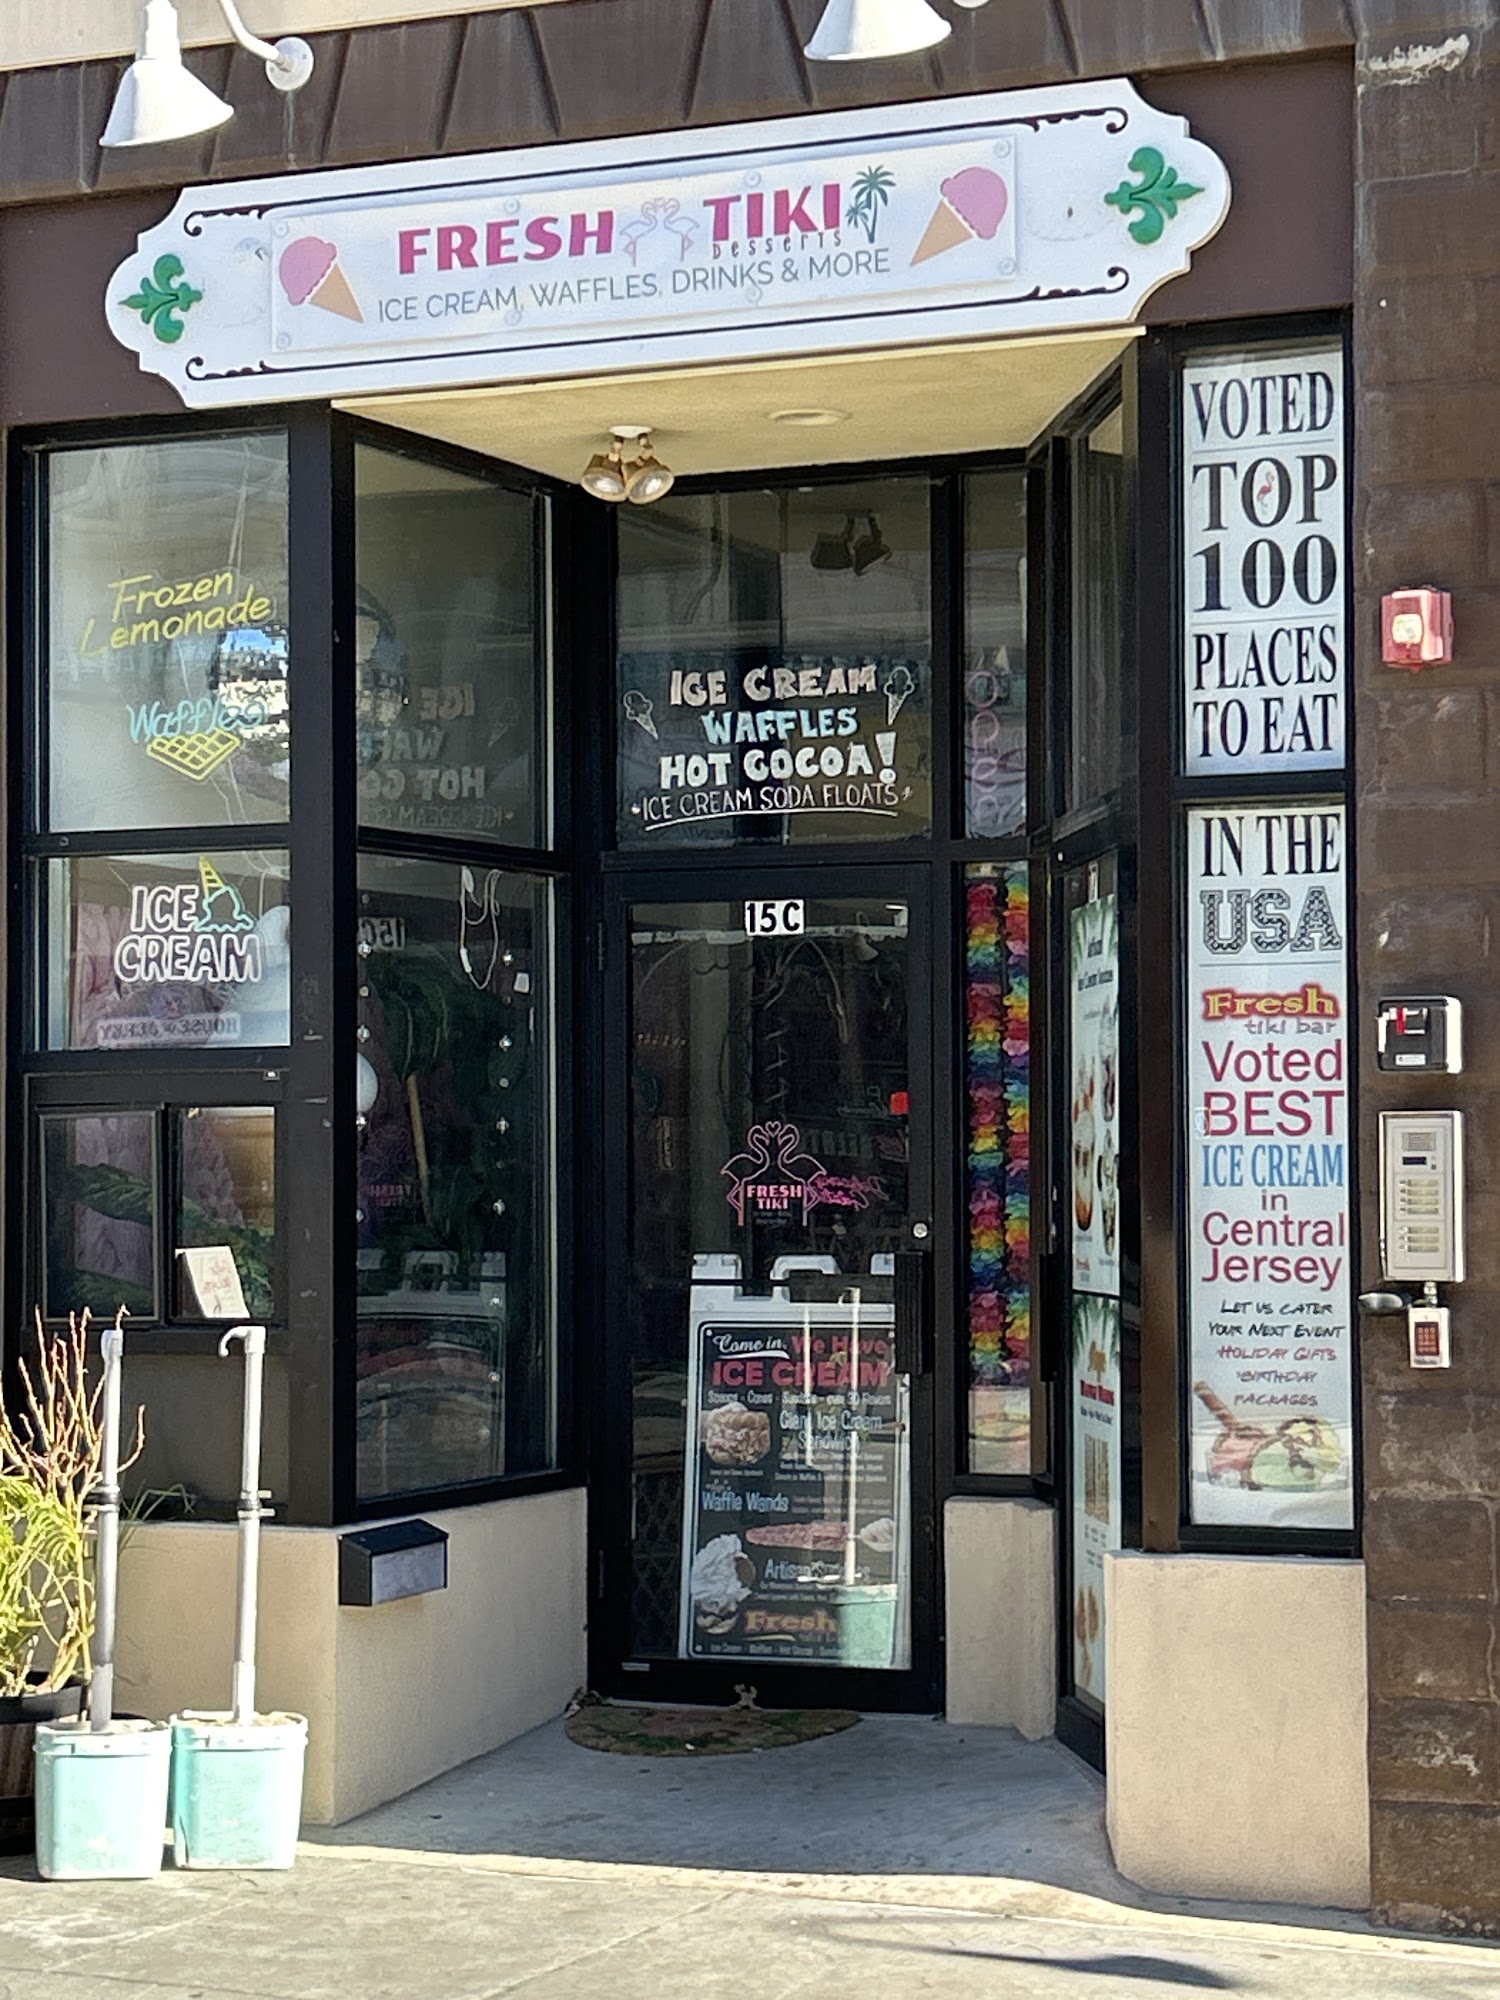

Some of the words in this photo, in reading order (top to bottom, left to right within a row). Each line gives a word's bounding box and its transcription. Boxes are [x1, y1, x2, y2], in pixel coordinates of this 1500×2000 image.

[399, 210, 614, 275] FRESH
[703, 184, 841, 242] TIKI
[378, 297, 418, 322] ICE
[426, 288, 524, 320] CREAM,
[529, 273, 662, 306] WAFFLES,
[671, 260, 773, 295] DRINKS
[781, 258, 799, 282] &
[809, 247, 890, 281] MORE
[1190, 370, 1335, 443] VOTED
[1192, 453, 1338, 532] TOP
[1192, 534, 1338, 612] 100
[107, 569, 234, 622] Frozen
[78, 583, 272, 656] Lemonade
[1193, 624, 1338, 692] PLACES
[670, 670, 727, 706] ICE
[743, 664, 877, 702] CREAM
[126, 698, 267, 744] Waffles
[701, 707, 858, 745] WAFFLES
[1193, 698, 1248, 758] TO
[1261, 693, 1338, 755] EAT
[659, 752, 732, 789] HOT
[743, 732, 898, 784] COCOA!
[642, 796, 673, 821] ICE
[680, 787, 752, 815] CREAM
[760, 785, 815, 811] SODA
[822, 783, 900, 807] FLOATS
[1200, 815, 1245, 877] IN
[1256, 812, 1341, 876] THE
[130, 884, 199, 932] ICE
[747, 902, 800, 933] 15C
[1200, 886, 1342, 955] USA
[114, 934, 263, 984] CREAM
[1201, 983, 1341, 1020] Fresh
[1296, 1018, 1337, 1035] bar
[1202, 1039, 1342, 1084] Voted
[1203, 1090, 1345, 1136] BEST
[1203, 1144, 1244, 1188] ICE
[1251, 1144, 1343, 1188] CREAM
[747, 1184, 802, 1198] FRESH
[756, 1197, 788, 1210] TIKI
[1261, 1189, 1288, 1211] in
[1203, 1211, 1345, 1248] Central
[1201, 1248, 1342, 1292] Jersey
[1209, 1321, 1242, 1337] YOUR
[1248, 1322, 1291, 1338] NEXT
[1294, 1324, 1346, 1338] EVENT
[1220, 1299, 1252, 1314] LET
[1256, 1302, 1273, 1315] US
[1279, 1302, 1333, 1316] CATER
[712, 1333, 765, 1354] Come
[1217, 1345, 1288, 1359] HOLIDAY
[1294, 1347, 1337, 1361] GIFTS
[712, 1361, 764, 1387] ICE
[771, 1361, 889, 1388] CREAM
[1234, 1393, 1318, 1406] PACKAGES
[702, 1491, 742, 1512] Waffle
[746, 1491, 790, 1512] Wands
[745, 1608, 838, 1632] Fresh
